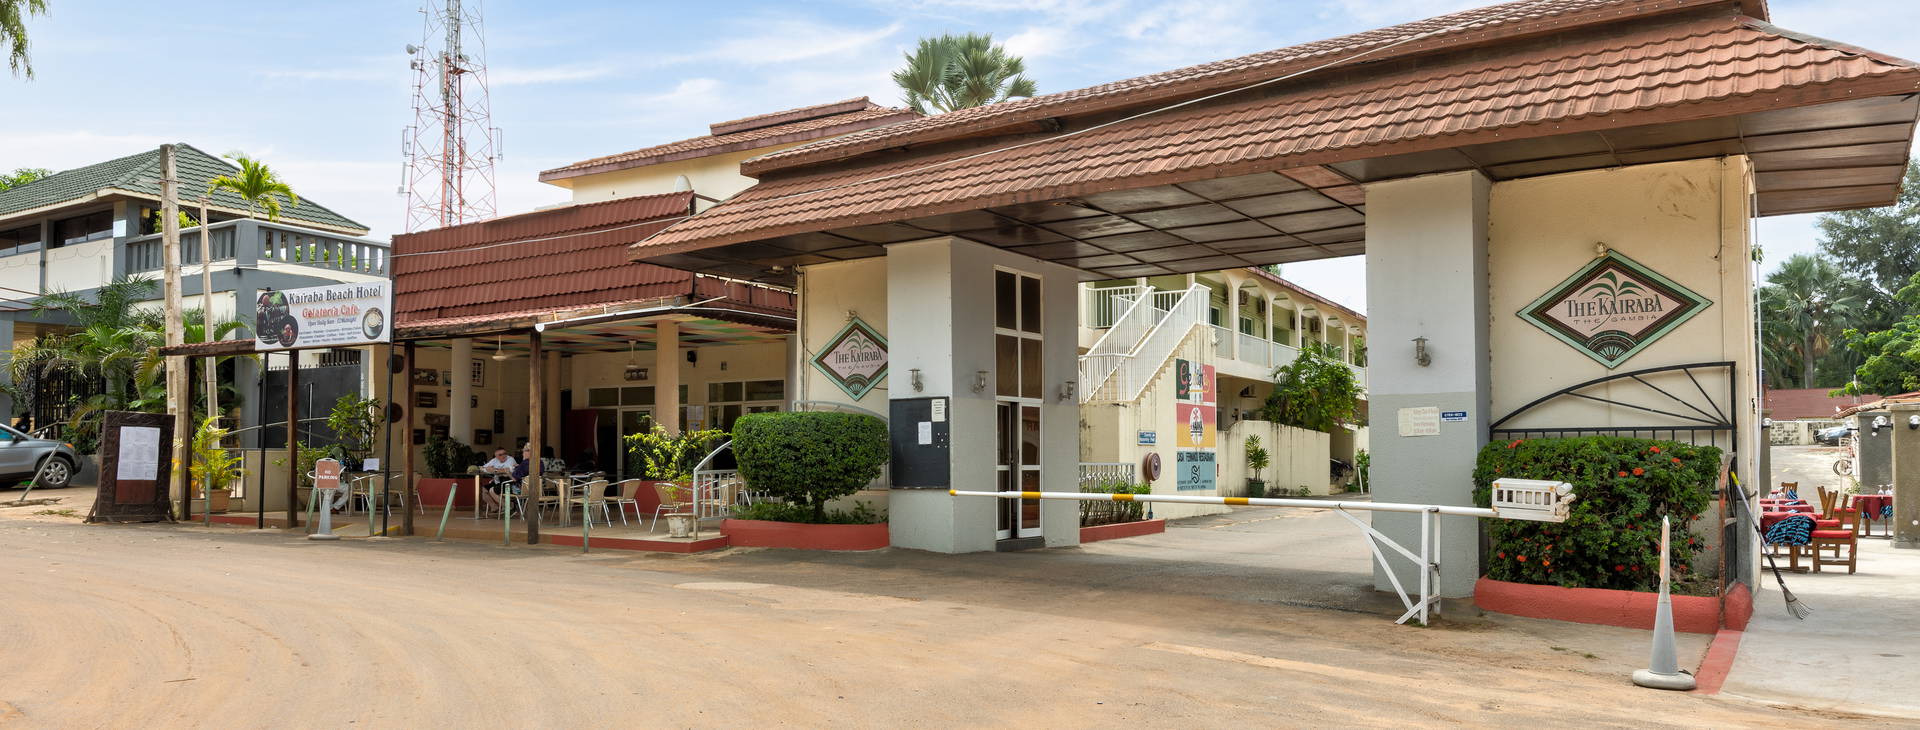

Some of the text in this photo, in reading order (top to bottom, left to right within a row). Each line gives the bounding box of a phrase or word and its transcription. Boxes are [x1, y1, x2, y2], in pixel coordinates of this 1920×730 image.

[289, 285, 381, 305] Kairaba Beach Hotel
[1564, 294, 1663, 318] THE KAIRABA
[1611, 314, 1658, 323] GAMBIA
[834, 348, 882, 364] THE KAIRABA
